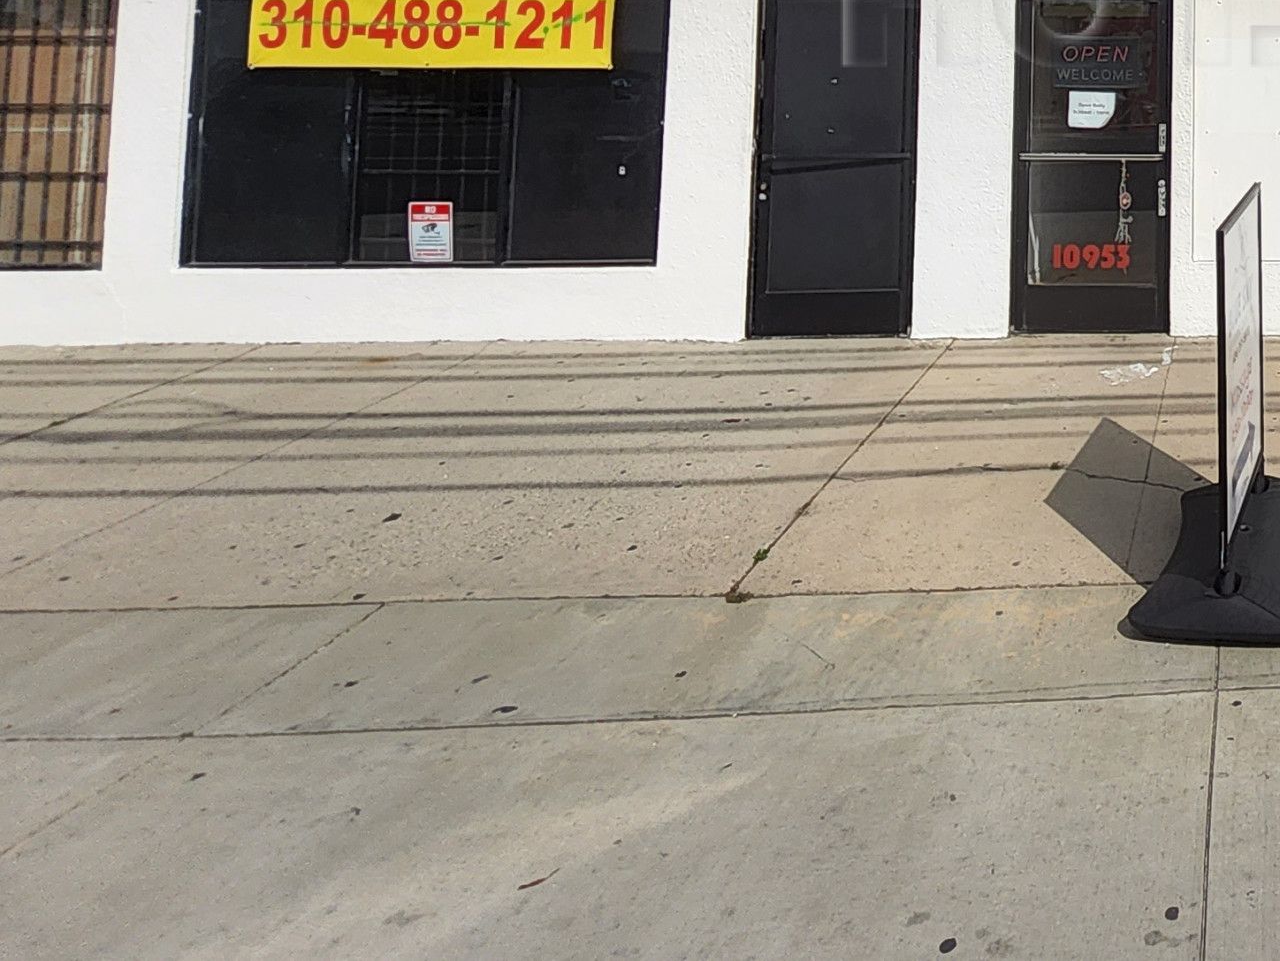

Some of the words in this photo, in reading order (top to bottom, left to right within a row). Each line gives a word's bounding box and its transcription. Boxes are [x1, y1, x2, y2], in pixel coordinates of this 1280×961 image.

[1063, 46, 1129, 62] OPEN
[1057, 68, 1134, 81] WELCOME
[1053, 244, 1131, 269] 10953
